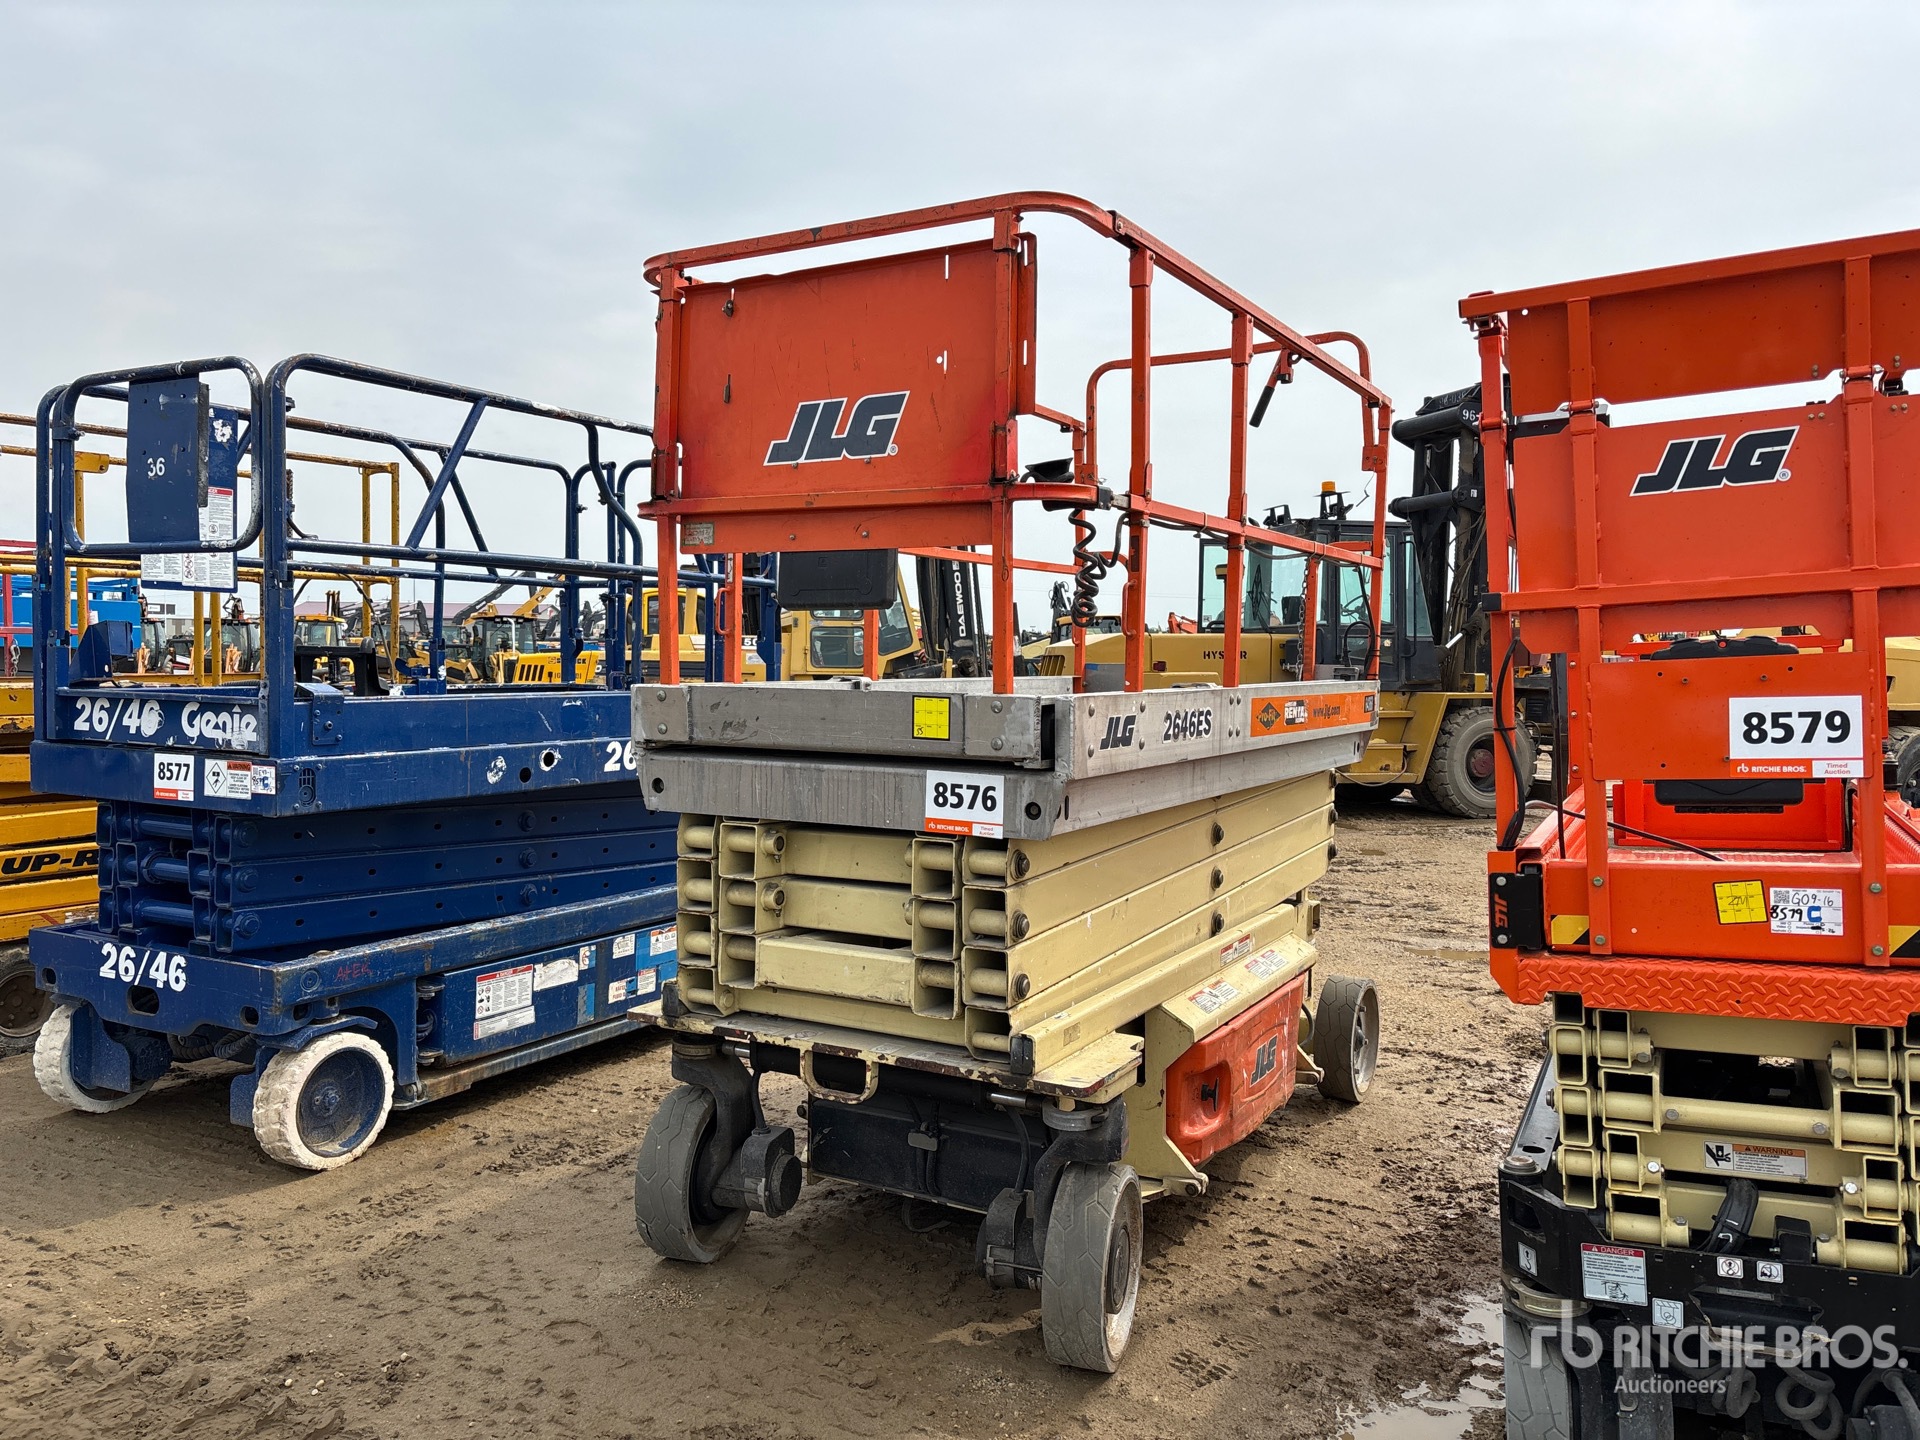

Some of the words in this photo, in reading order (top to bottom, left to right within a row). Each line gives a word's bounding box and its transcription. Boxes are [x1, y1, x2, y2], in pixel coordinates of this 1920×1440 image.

[763, 391, 910, 466] JLG
[147, 457, 166, 477] 36
[1630, 425, 1799, 497] JLG
[954, 572, 966, 637] DAEWOO
[1203, 650, 1247, 660] HYSR
[74, 696, 161, 740] 26/46
[181, 701, 258, 745] Genie
[1100, 714, 1137, 750] JLG
[1163, 708, 1213, 744] 2646ES
[1742, 710, 1851, 745] 8579
[157, 761, 190, 782] 8577
[1752, 766, 1782, 774] RITCHIE
[1783, 765, 1807, 774] BROS.
[1824, 768, 1851, 776] Auction
[933, 782, 997, 812] 8576
[1494, 893, 1509, 928] JLG
[1770, 905, 1803, 922] 8579
[1807, 905, 1822, 922] C
[100, 942, 187, 992] 26/46
[1250, 1033, 1278, 1088] JLG
[1752, 1146, 1794, 1156] WARNING
[1600, 1246, 1635, 1256] DANGER
